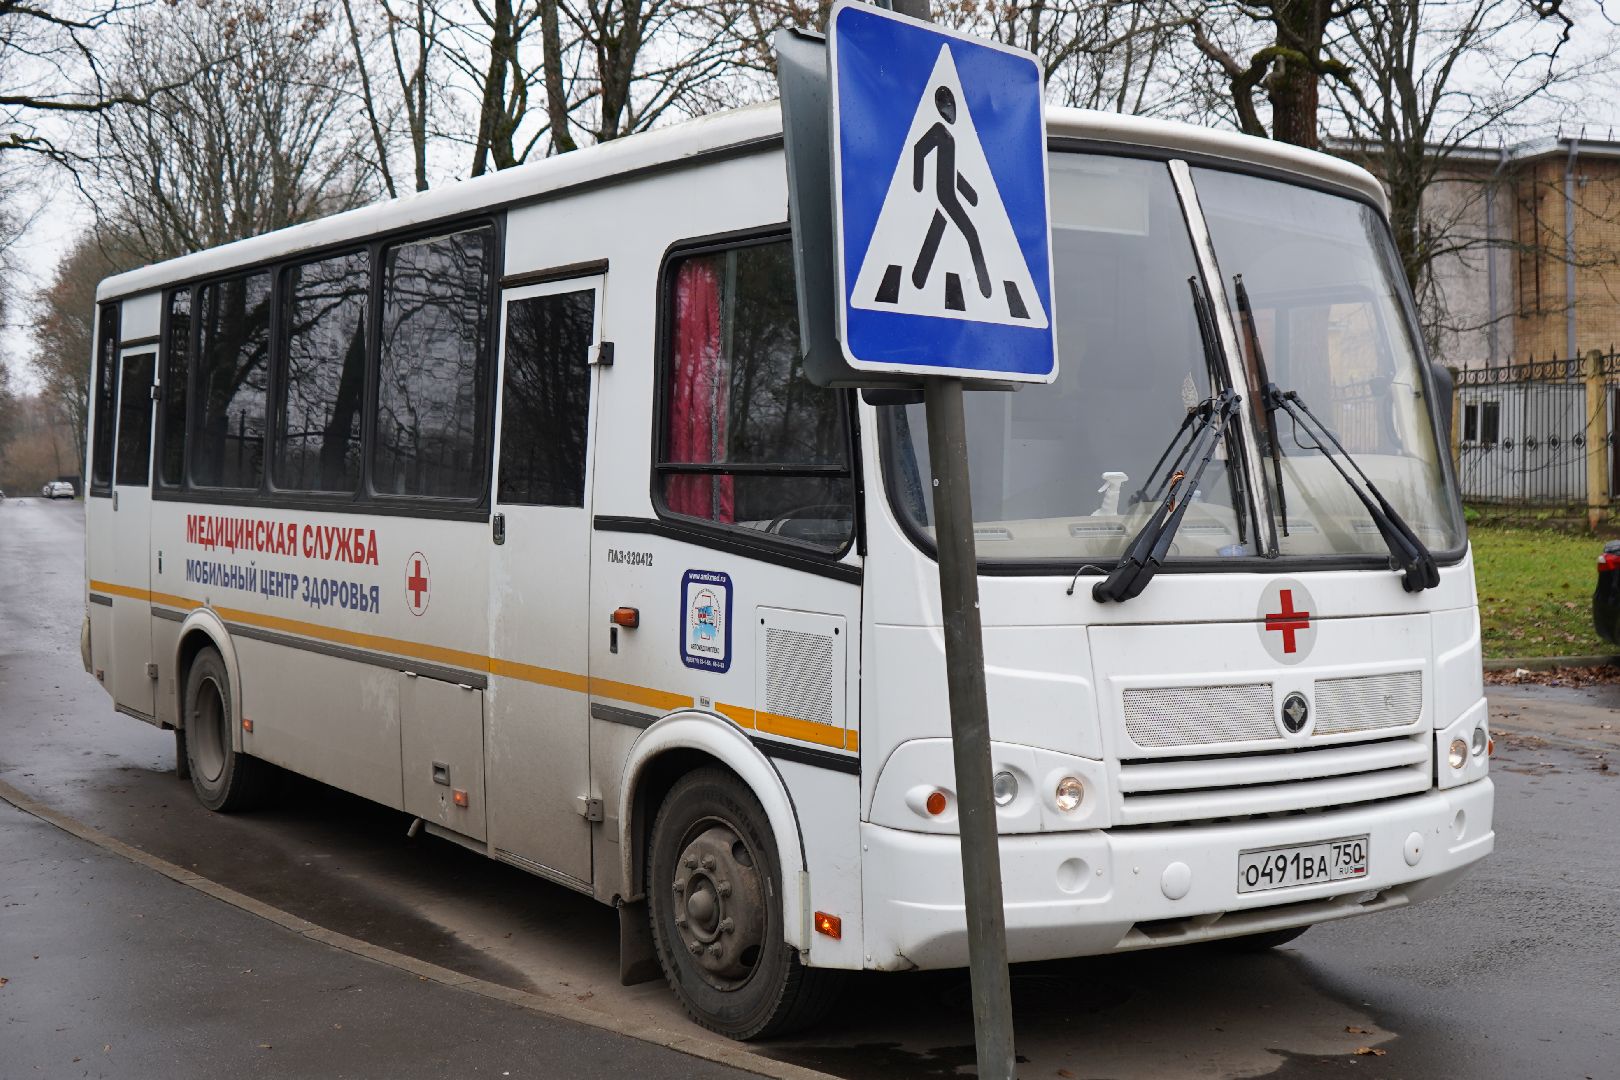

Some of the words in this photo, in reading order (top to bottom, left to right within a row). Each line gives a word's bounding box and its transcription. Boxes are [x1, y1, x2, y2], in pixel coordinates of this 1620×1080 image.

[186, 514, 298, 557] МЕДИЦИНСКАЯ
[302, 524, 379, 566] СЛУЖБА
[186, 559, 257, 593] МОБИЛЬНЫЙ
[260, 570, 299, 600] ЦЕНТР
[302, 575, 380, 614] ЗДОРОВЬЯ
[1332, 842, 1362, 868] 750
[1339, 866, 1354, 875] RUS
